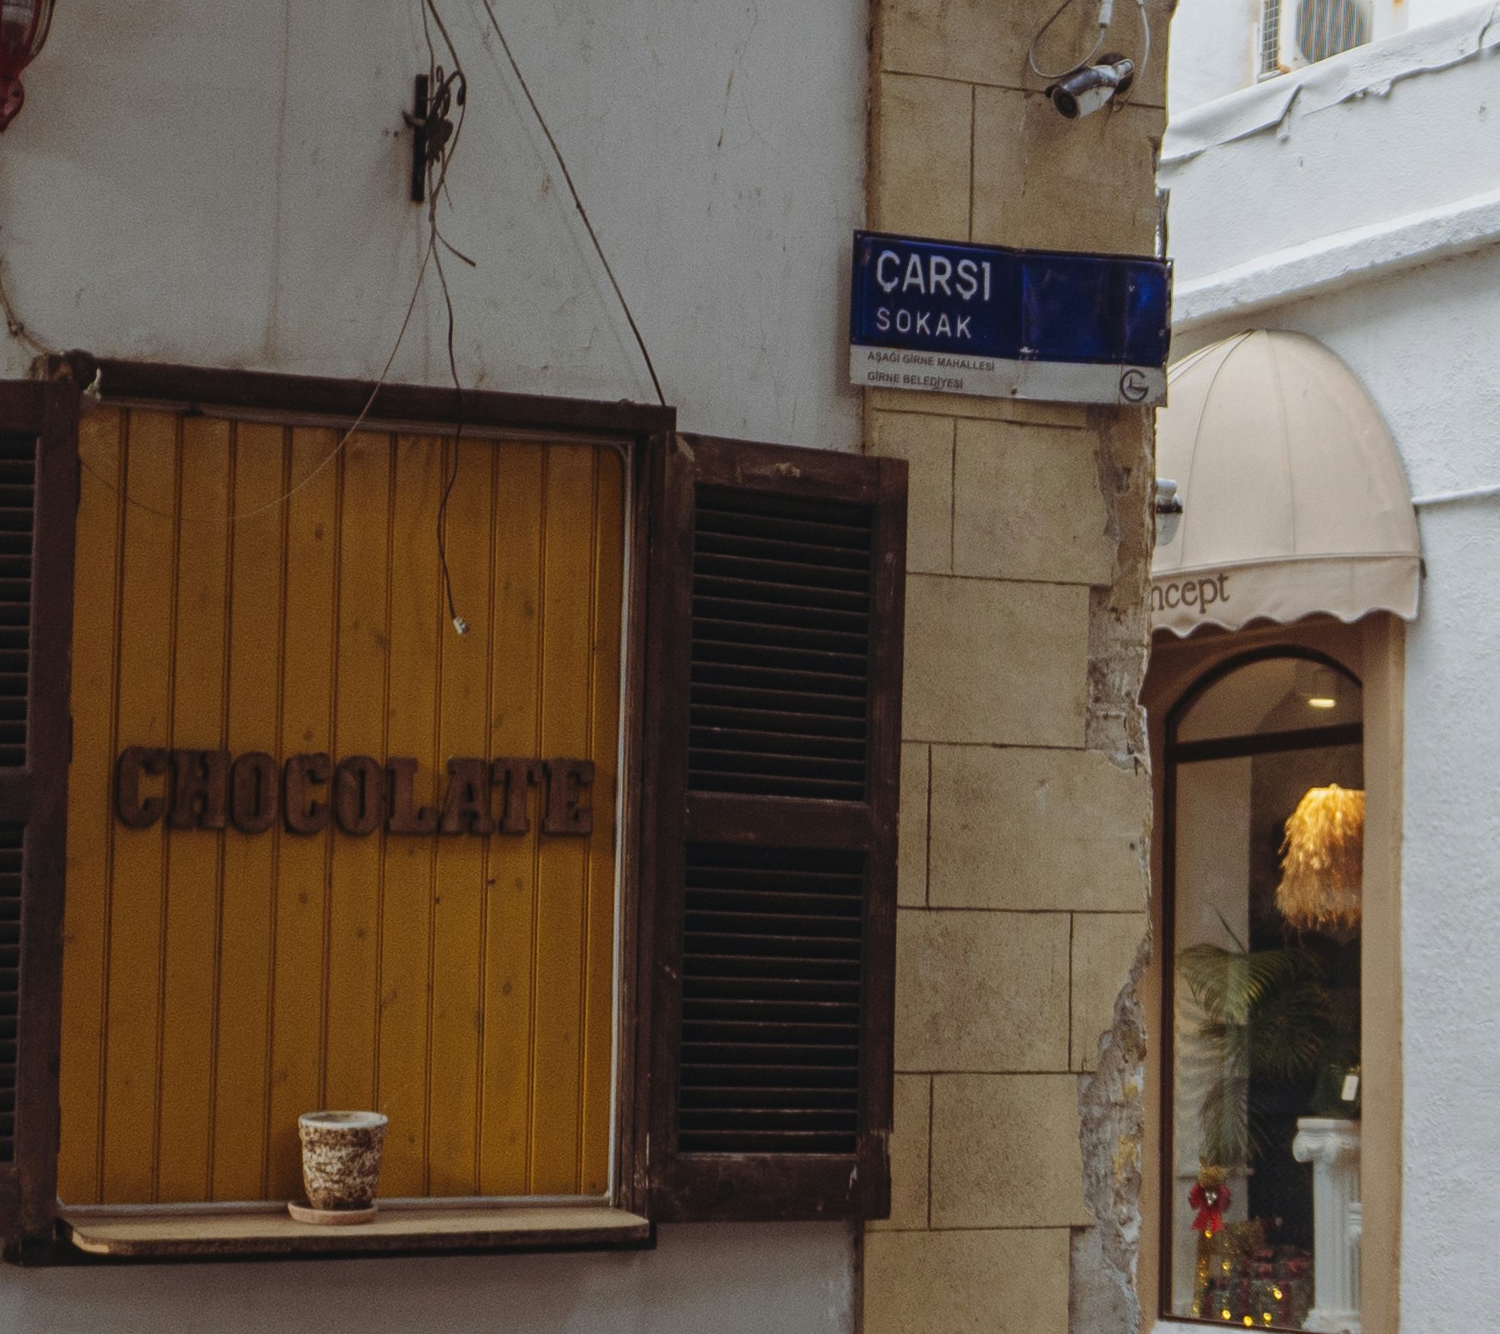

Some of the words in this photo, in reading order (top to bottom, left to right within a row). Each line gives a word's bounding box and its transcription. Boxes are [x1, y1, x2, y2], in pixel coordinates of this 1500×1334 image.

[876, 250, 991, 302] ÇARŞI
[875, 307, 973, 340] SOKAK
[867, 350, 900, 364] AŞAĞI
[902, 353, 934, 367] GİRNE
[936, 357, 995, 372] MAHALLESİ
[867, 370, 900, 383] GİRNE
[902, 374, 964, 389] BELEDİYESİ
[114, 744, 595, 838] CHOCOLATE
